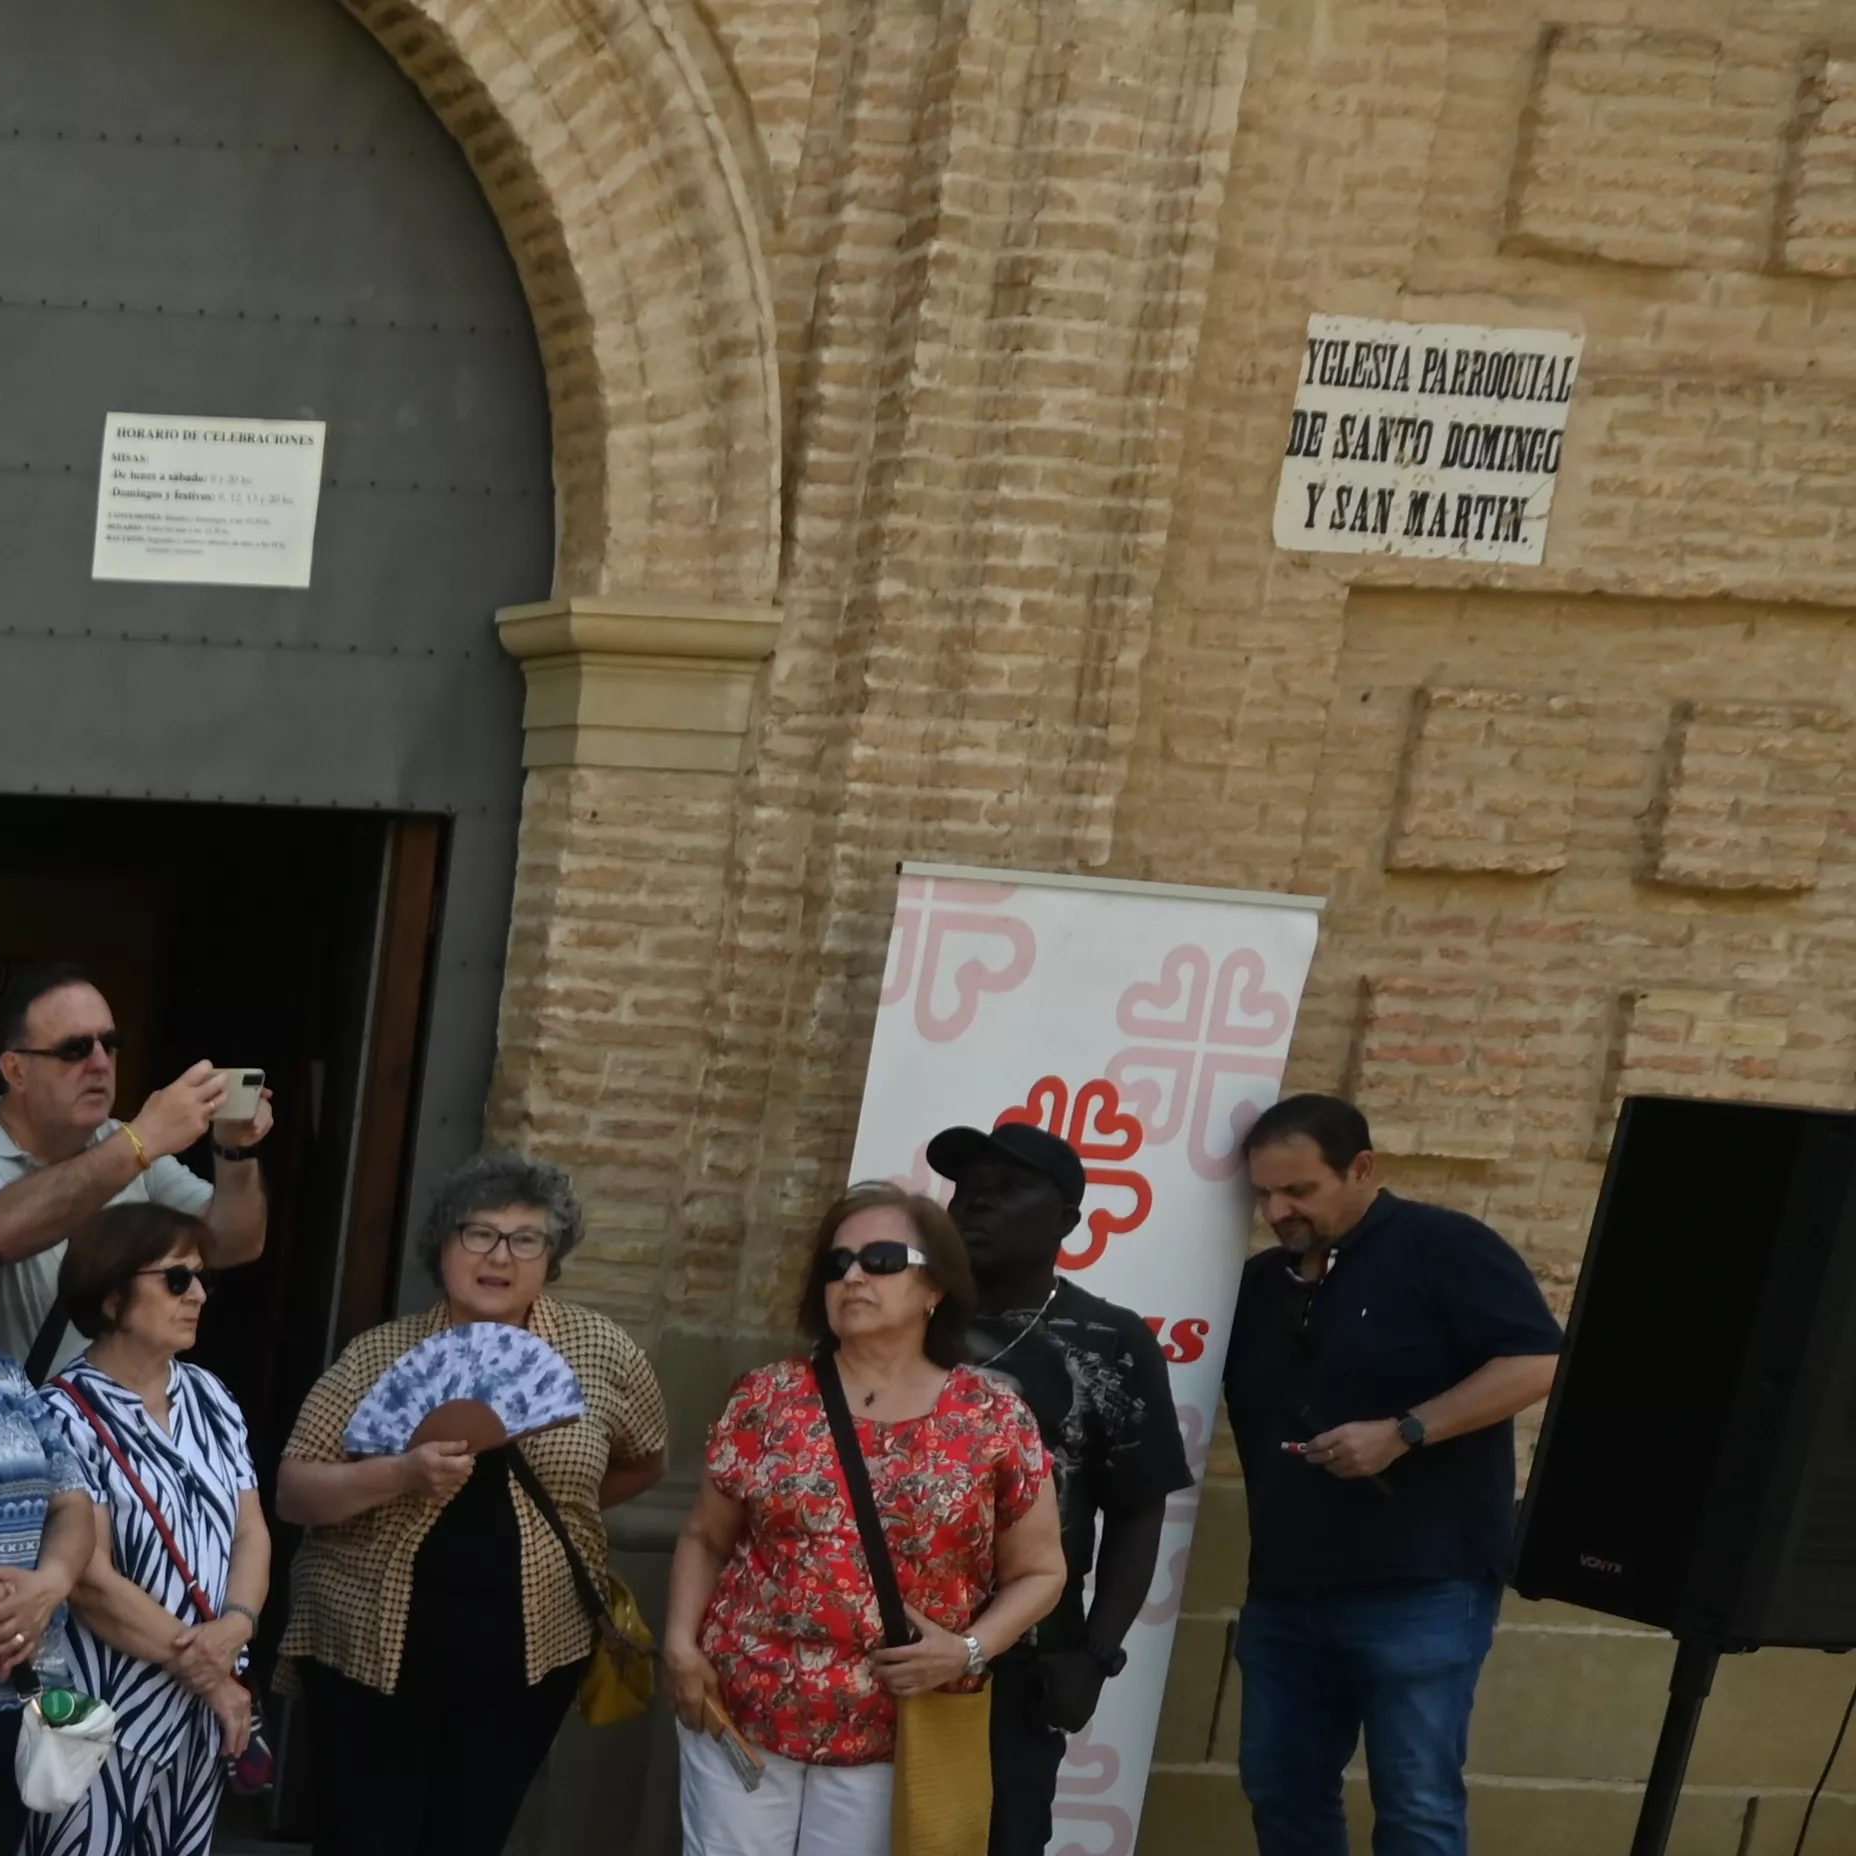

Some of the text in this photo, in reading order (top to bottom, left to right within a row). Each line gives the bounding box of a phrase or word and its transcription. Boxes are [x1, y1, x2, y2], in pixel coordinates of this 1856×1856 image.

[1305, 338, 1573, 403] YGLESIA PARROQUIAL
[116, 427, 315, 446] HORARIO DE CELEBRACIONES
[1286, 409, 1565, 474] DE SANTO DOMINGO
[1304, 483, 1529, 544] Y SAN MARTIN.
[1580, 1553, 1624, 1574] VONYX
